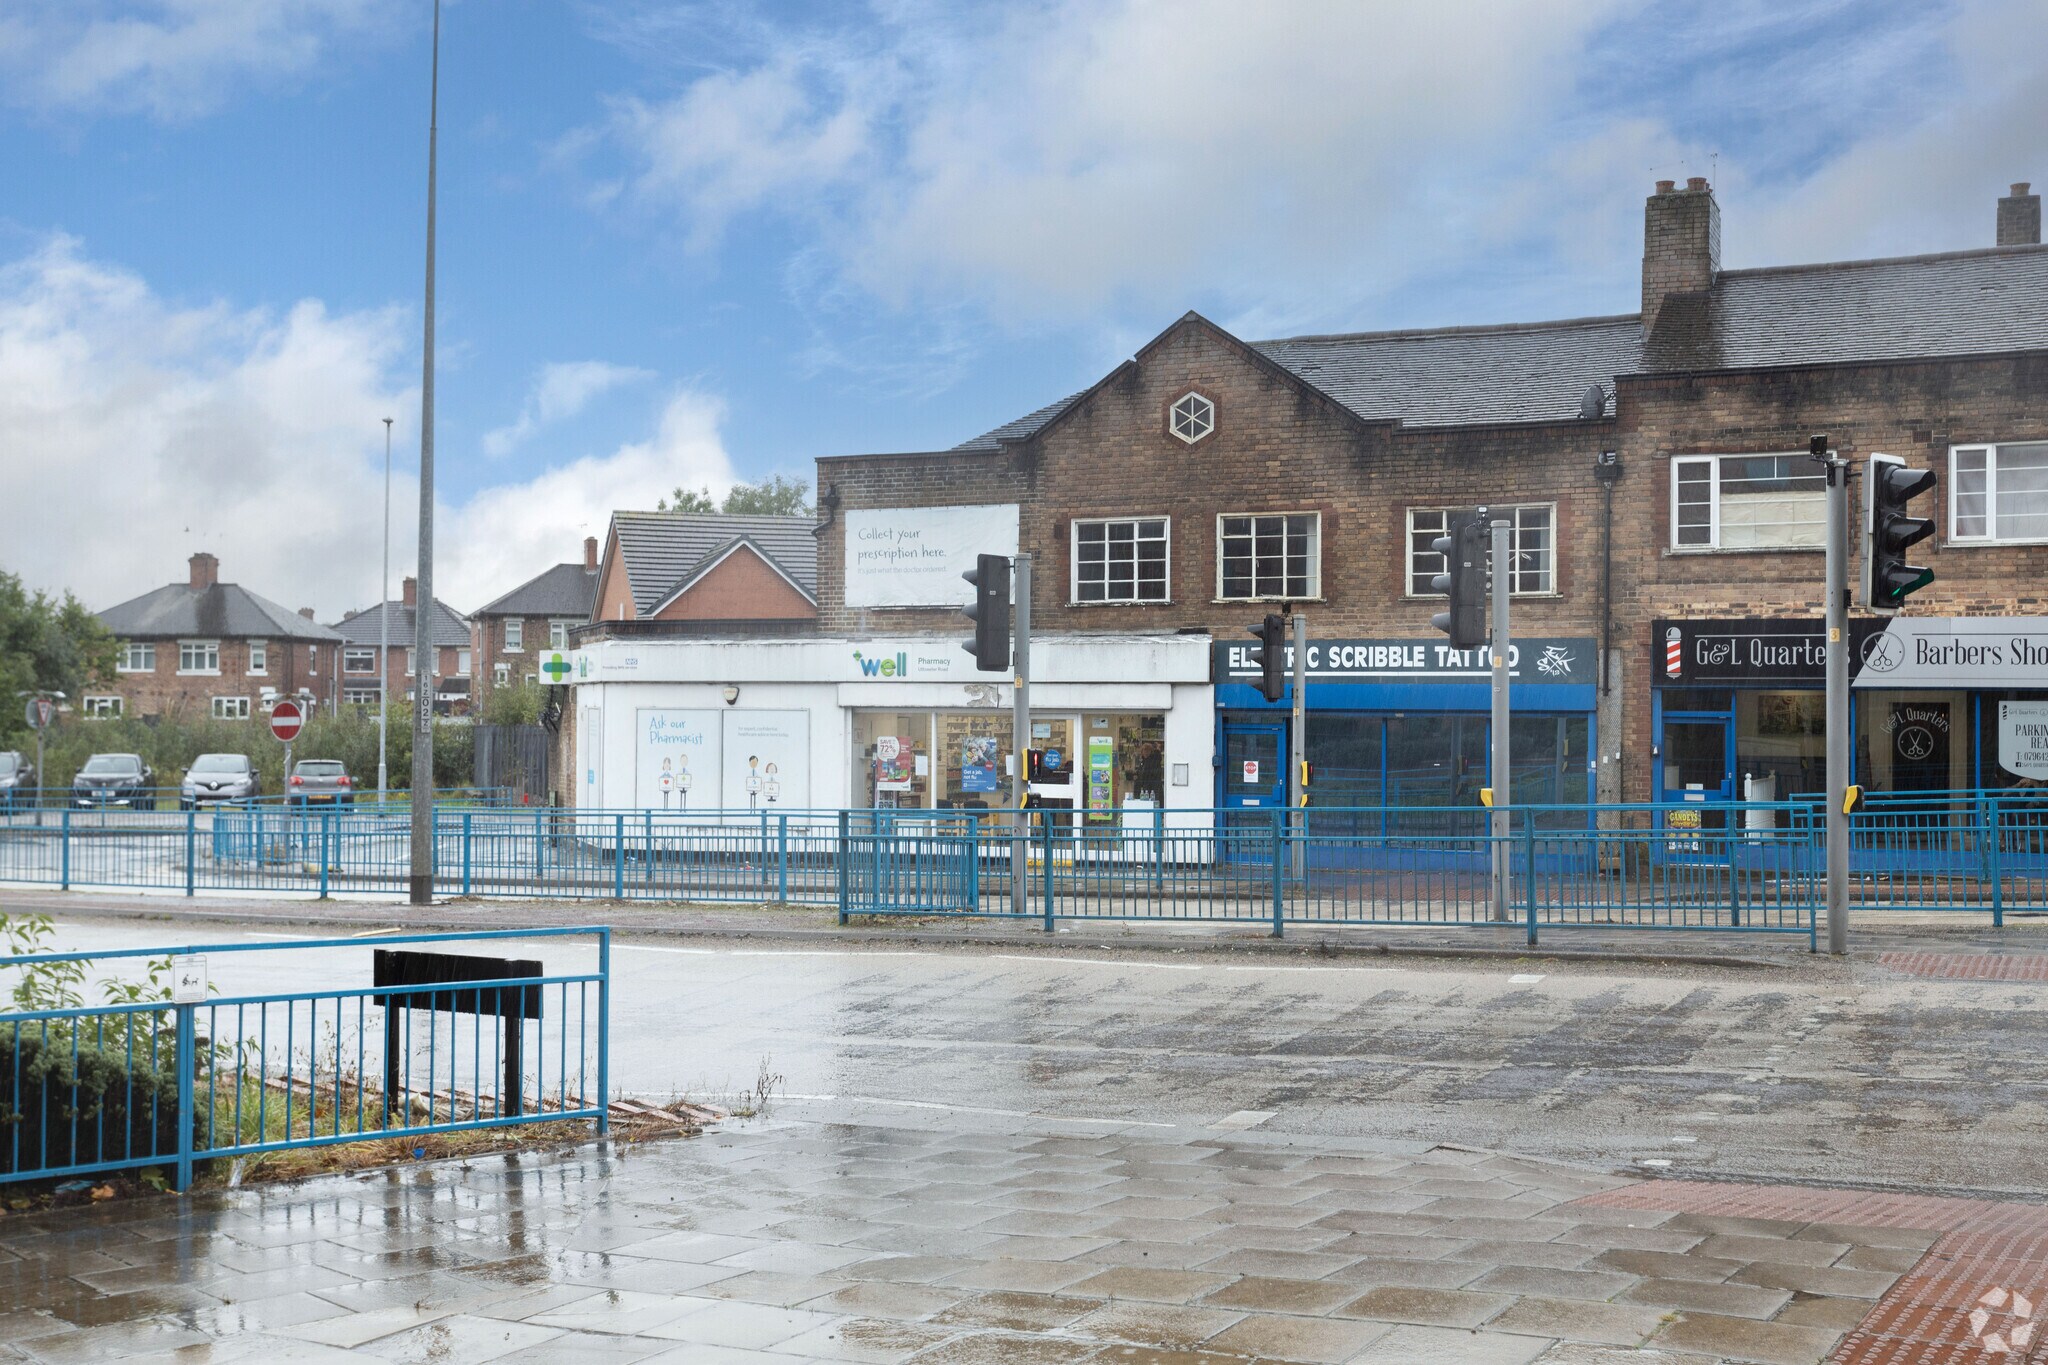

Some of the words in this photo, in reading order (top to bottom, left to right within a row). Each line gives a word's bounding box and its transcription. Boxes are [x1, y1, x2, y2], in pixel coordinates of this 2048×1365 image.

[858, 528, 893, 541] Collect
[897, 529, 921, 545] your
[857, 547, 918, 565] prescription
[922, 544, 947, 558] here.
[865, 567, 877, 575] just
[1831, 629, 1838, 640] 3
[1329, 646, 1425, 668] SCRIBBLE
[1434, 646, 1519, 668] TATTO
[1696, 638, 1742, 665] G&L
[1751, 638, 1850, 667] Quarte
[1916, 638, 2002, 666] Barbers
[2011, 637, 2048, 666] Sho
[861, 652, 907, 677] well
[918, 657, 951, 666] Pharmacy
[650, 715, 666, 730] Ask
[671, 720, 686, 729] our
[1906, 707, 1950, 732] Quarters
[650, 731, 703, 745] Pharmacist
[880, 744, 896, 753] 72%
[1669, 812, 1698, 821] GANDEYS
